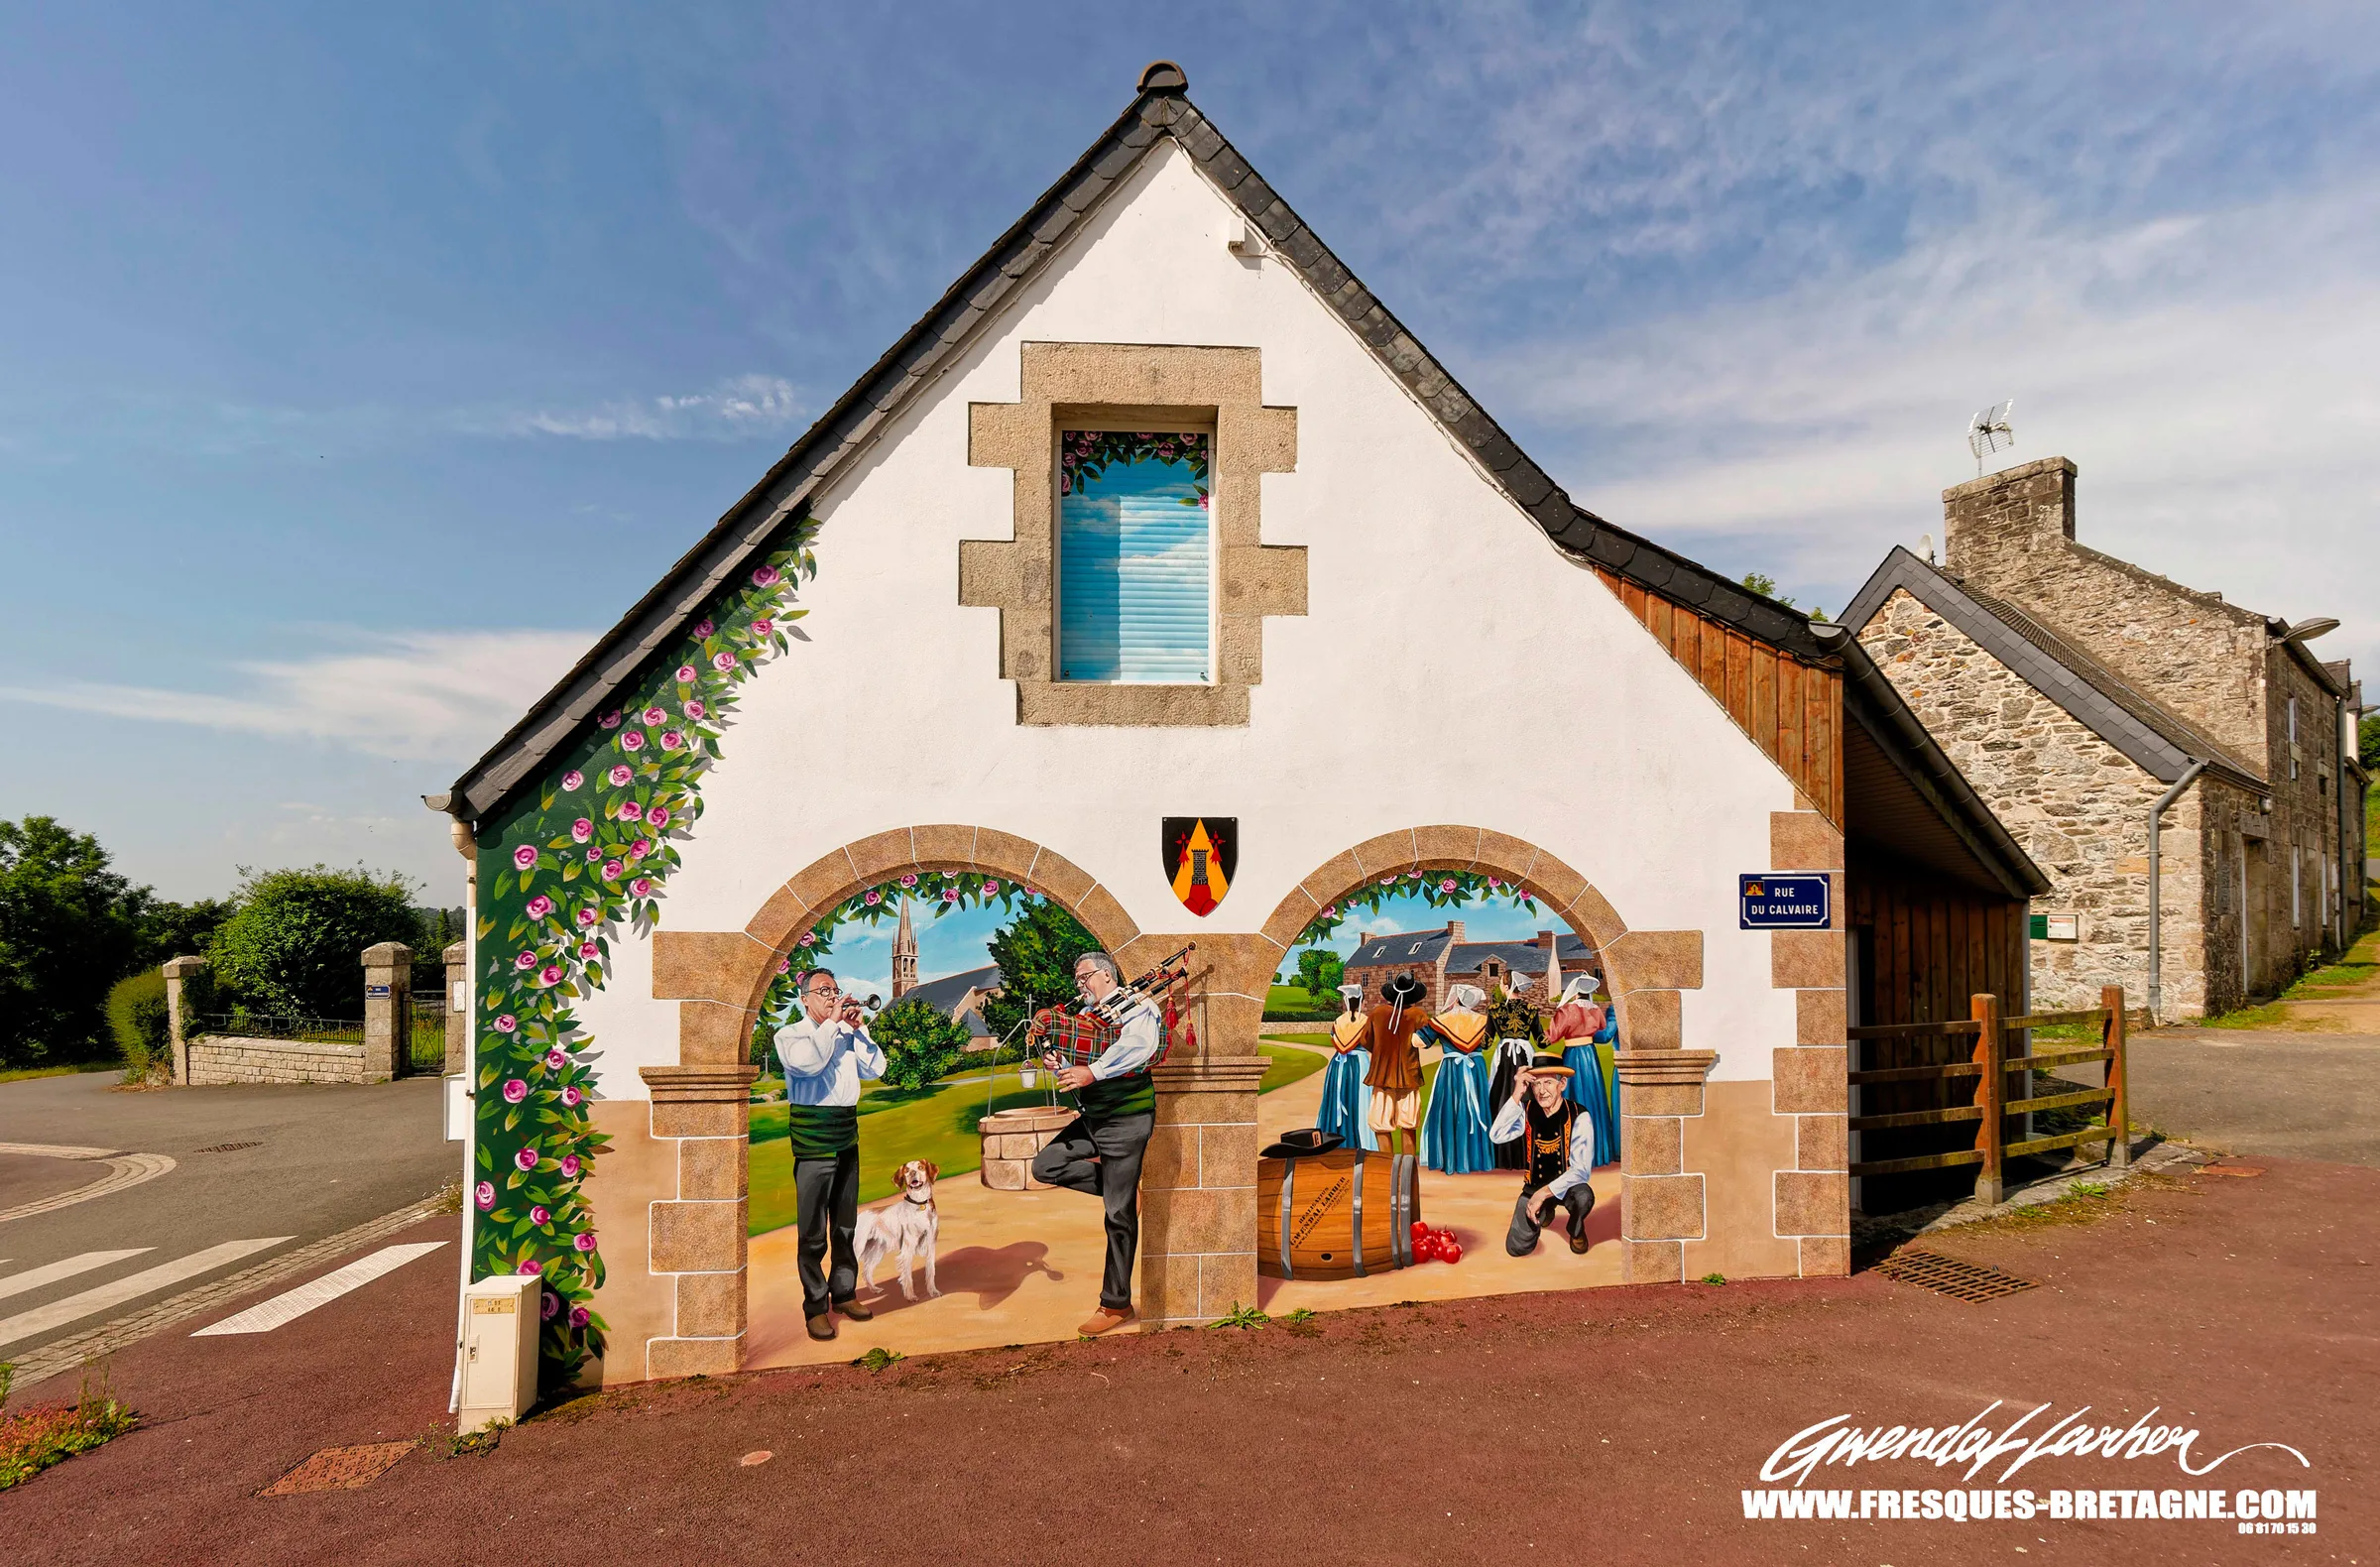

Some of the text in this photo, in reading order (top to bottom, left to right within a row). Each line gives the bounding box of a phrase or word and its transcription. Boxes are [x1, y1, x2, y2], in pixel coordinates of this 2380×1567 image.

[1774, 888, 1795, 898] RUE
[1751, 904, 1819, 914] DU CALVAIRE
[1290, 1208, 1322, 1246] GWENDAL
